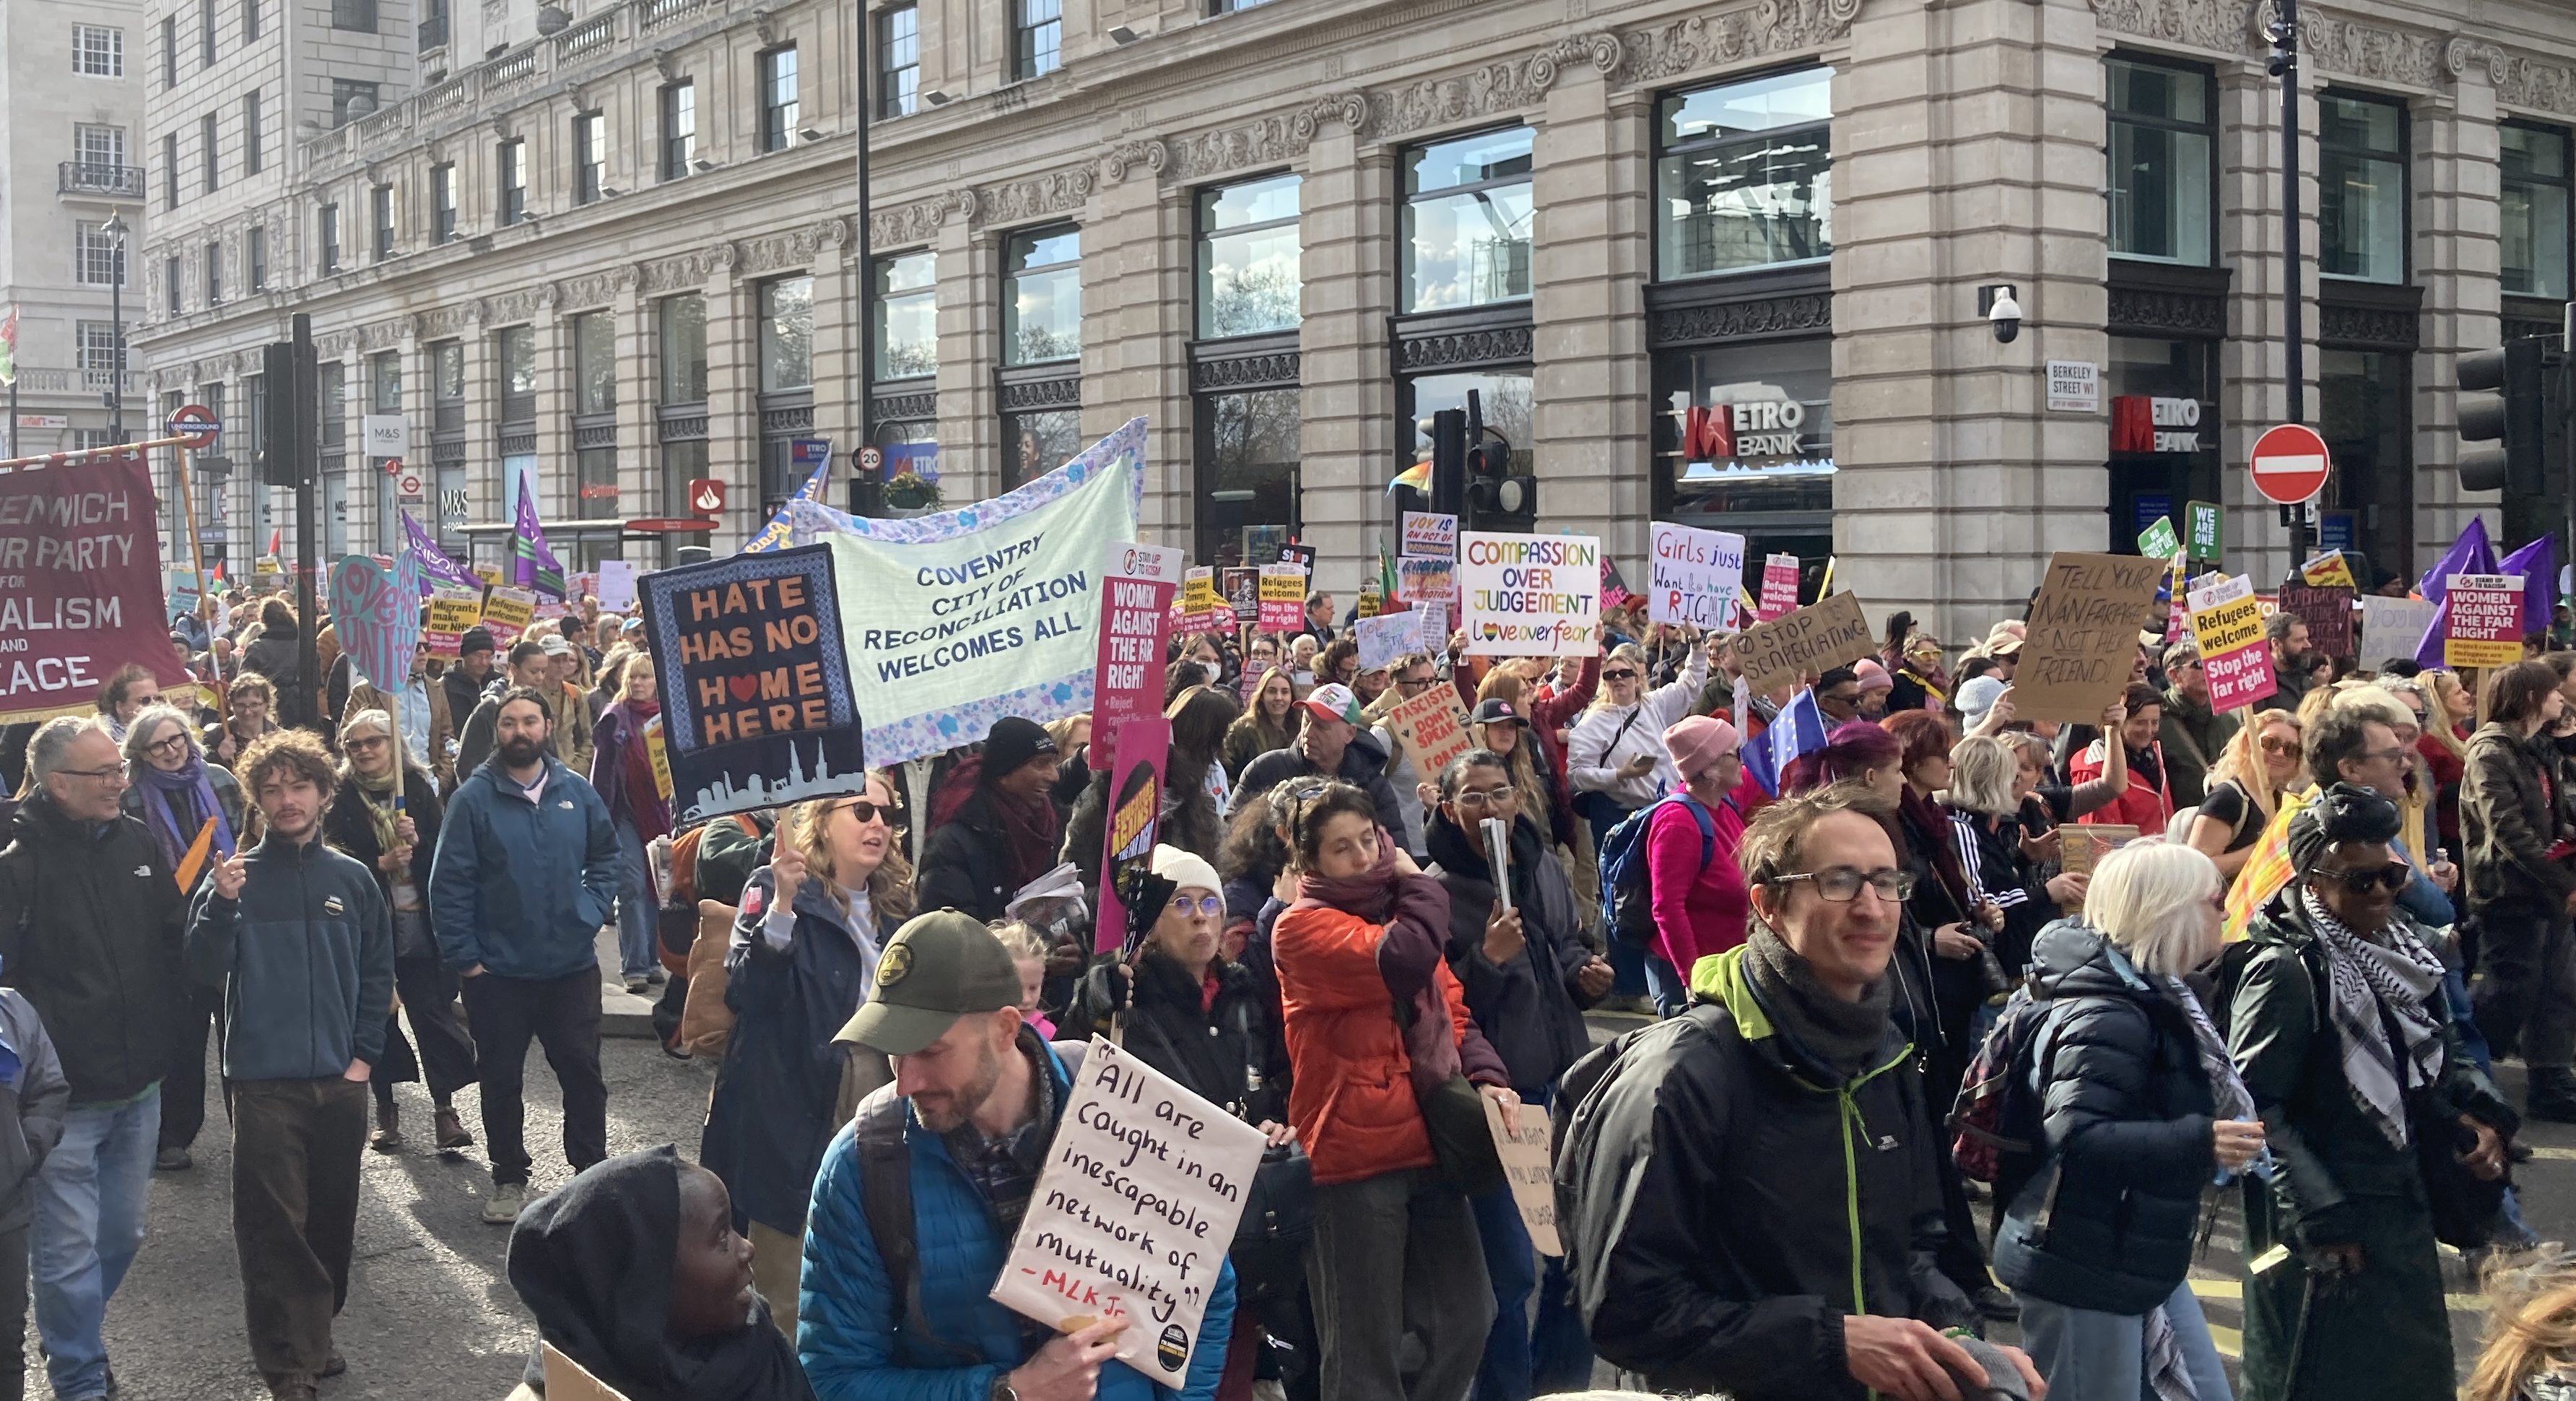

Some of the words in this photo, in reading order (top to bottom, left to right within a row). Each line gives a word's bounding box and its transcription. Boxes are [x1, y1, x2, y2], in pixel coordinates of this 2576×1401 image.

[2053, 365, 2091, 379] BERKELEY
[2053, 381, 2081, 394] STREET
[2083, 383, 2094, 394] W1
[375, 428, 400, 438] M&S
[1684, 400, 1805, 459] METRO
[1736, 433, 1805, 456] BANK
[2154, 431, 2200, 452] BANK
[863, 454, 879, 464] 20
[1408, 516, 1437, 529] JOY
[1438, 519, 1453, 532] IS
[2196, 506, 2215, 523] WE
[1406, 531, 1419, 539] AN
[1422, 532, 1438, 541] ACT
[2149, 528, 2160, 542] NO
[2196, 521, 2215, 534] ARE
[1657, 532, 1705, 563] Girls
[1709, 545, 1741, 570] just
[2195, 533, 2214, 546] ONE
[35, 534, 134, 572] PARTY
[917, 532, 1045, 586] COVENTRY
[1152, 554, 1161, 563] UP
[1468, 541, 1594, 566] COMPASSION
[1262, 577, 1302, 589] Refugees
[1502, 568, 1553, 589] OVER
[1654, 563, 1684, 591] Want
[1688, 572, 1703, 593] to
[1707, 575, 1733, 596] have
[2058, 565, 2107, 590] TELL
[2109, 563, 2154, 594] YOUR
[691, 576, 805, 622] HATE
[932, 582, 993, 616] CITY
[998, 567, 1027, 592] OF
[1185, 592, 1206, 602] Tommy
[1262, 589, 1301, 598] welcome
[1474, 589, 1593, 615] JUDGEMENT
[1762, 591, 1796, 602] welcome
[2452, 591, 2510, 604] WOMEN
[433, 610, 459, 622] make
[434, 600, 478, 613] Migrants
[487, 610, 524, 623] welcome
[489, 598, 529, 615] Refugees
[864, 570, 1087, 650] RECONCILIATION
[1185, 602, 1212, 613] Robinson
[1261, 602, 1282, 614] Stop
[1284, 603, 1299, 612] the
[1668, 590, 1739, 628] RIGHTS
[1762, 599, 1783, 612] here
[2037, 593, 2087, 626] NAN
[2197, 602, 2256, 632] Refugees
[2451, 603, 2518, 616] AGAINST
[1110, 610, 1160, 636] AGAINST
[1261, 613, 1274, 623] far
[1276, 613, 1297, 625] right
[2451, 615, 2481, 626] THE
[2484, 616, 2513, 628] FAR
[679, 626, 754, 664] HAS
[765, 614, 818, 653] NO
[1760, 615, 1813, 649] STOP
[2053, 628, 2093, 651] NOT
[2202, 623, 2258, 651] welcome
[2451, 626, 2499, 639] RIGHT
[877, 626, 1024, 682] WELCOMES
[1034, 612, 1082, 641] ALL
[1110, 637, 1136, 662] THE
[2207, 658, 2242, 679] Stop
[2242, 649, 2263, 667] the
[1107, 664, 1145, 689] RIGHT
[2212, 680, 2234, 699] far
[2238, 667, 2267, 693] right
[1391, 683, 1454, 725] FASCISTS
[704, 698, 829, 745] HERE
[1416, 719, 1459, 750] SPEAK
[1424, 750, 1450, 772] FOR
[1112, 791, 1155, 858] AGAINST
[1154, 1100, 1205, 1140] are
[1177, 1150, 1203, 1179] in
[1208, 1171, 1239, 1203] an
[1062, 1140, 1210, 1239] inescapable
[1045, 1189, 1155, 1255] network
[1168, 1251, 1198, 1280] of
[1103, 1296, 1126, 1318] Jr
